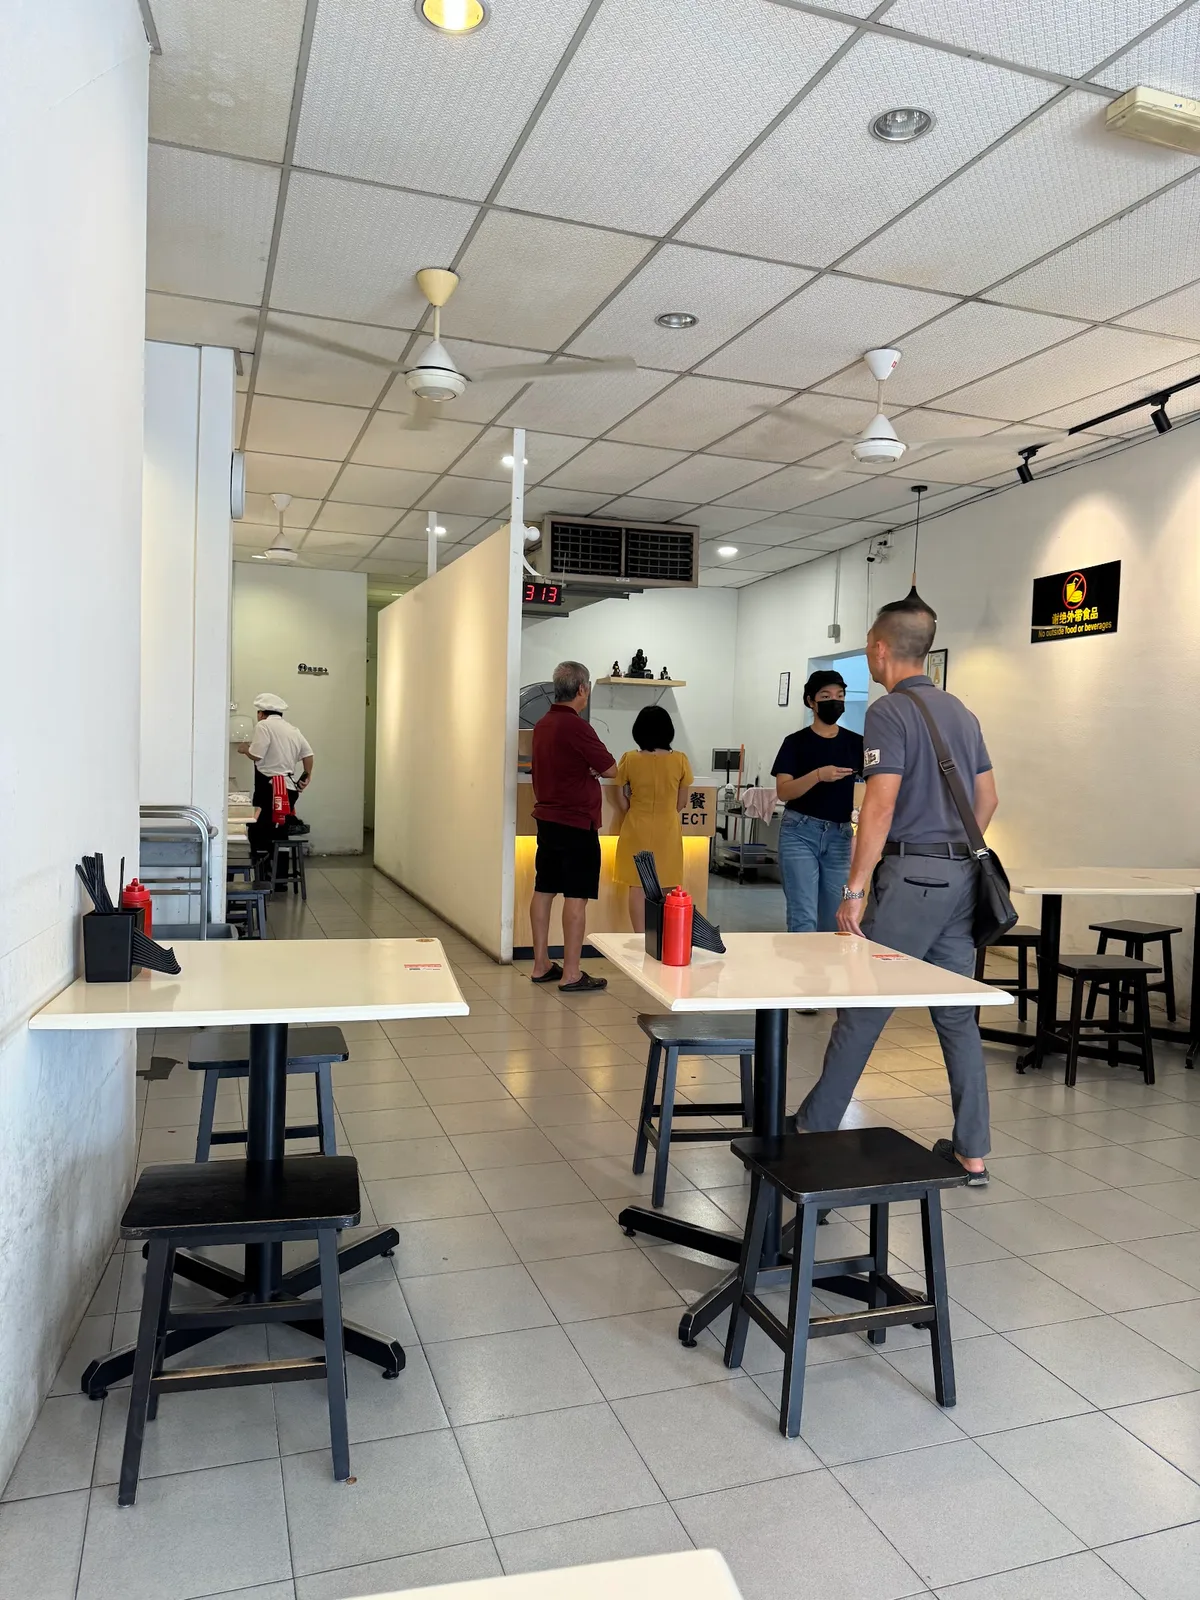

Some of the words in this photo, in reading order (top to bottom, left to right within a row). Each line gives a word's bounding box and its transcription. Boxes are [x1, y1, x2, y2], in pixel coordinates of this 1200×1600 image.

[1038, 630, 1045, 638] No
[1046, 627, 1064, 637] outside
[1065, 624, 1077, 634] food
[1084, 621, 1112, 631] beverages
